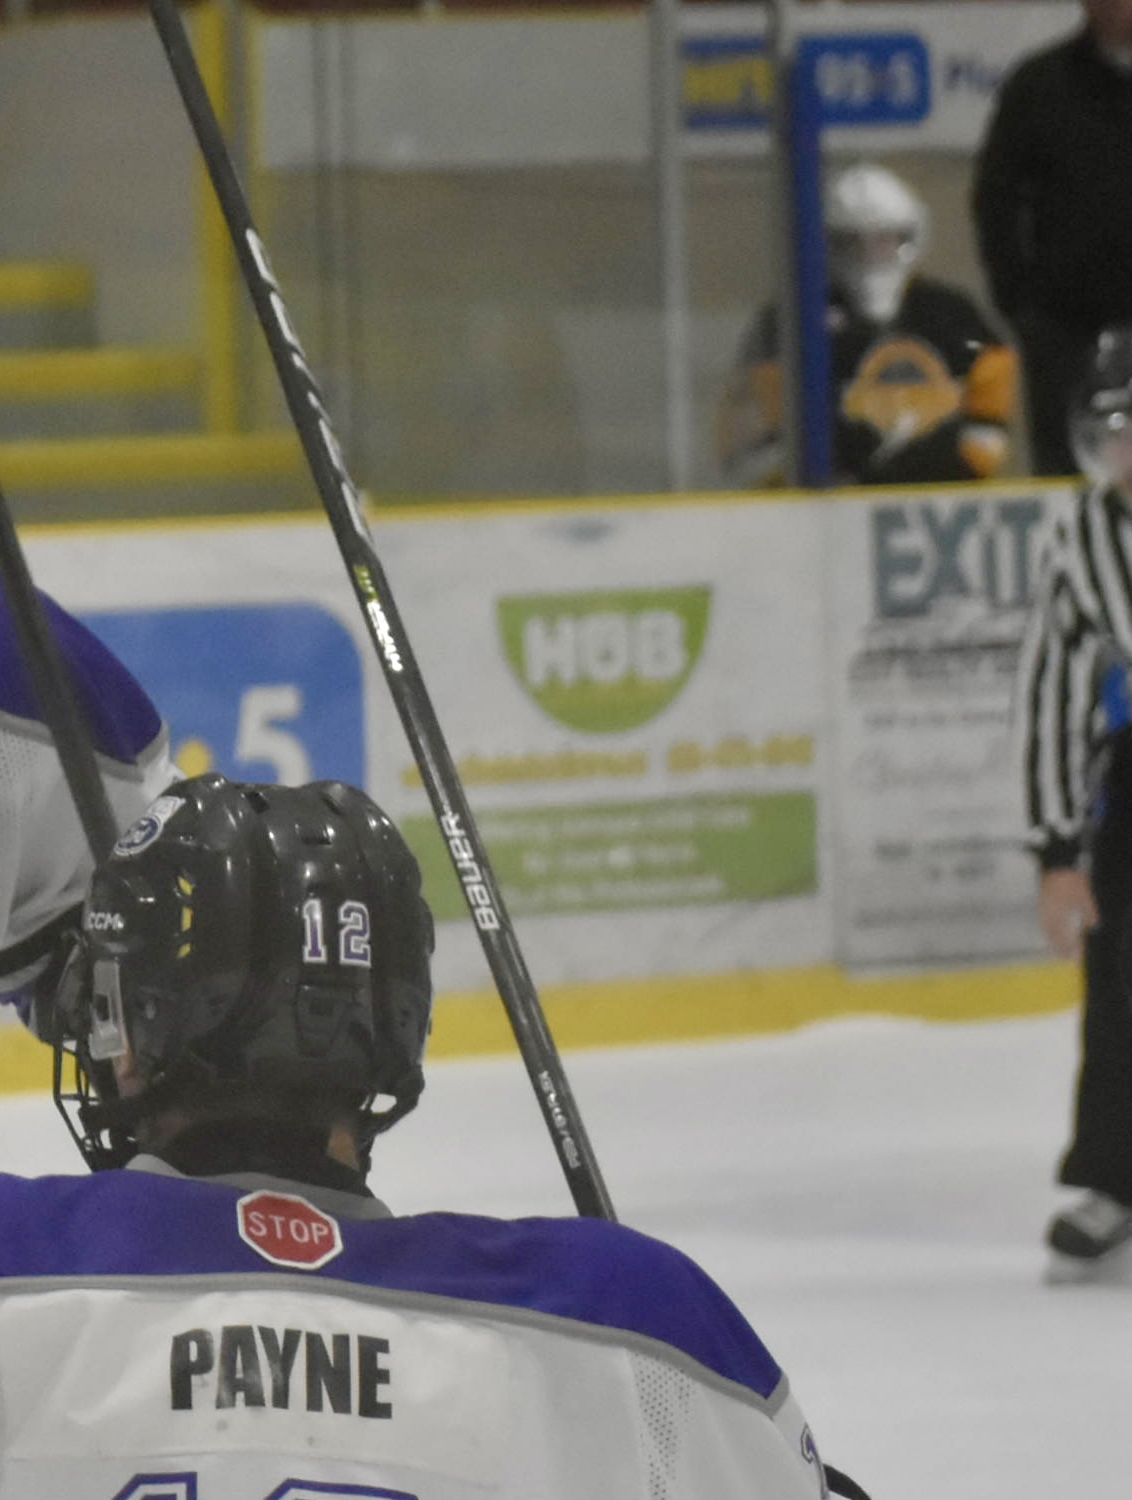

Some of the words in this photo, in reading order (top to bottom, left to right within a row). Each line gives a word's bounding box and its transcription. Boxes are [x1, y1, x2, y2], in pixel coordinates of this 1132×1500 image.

[440, 810, 501, 931] BAUER
[301, 897, 372, 968] 12
[246, 1208, 329, 1247] STOP
[170, 1324, 393, 1420] PAYNE
